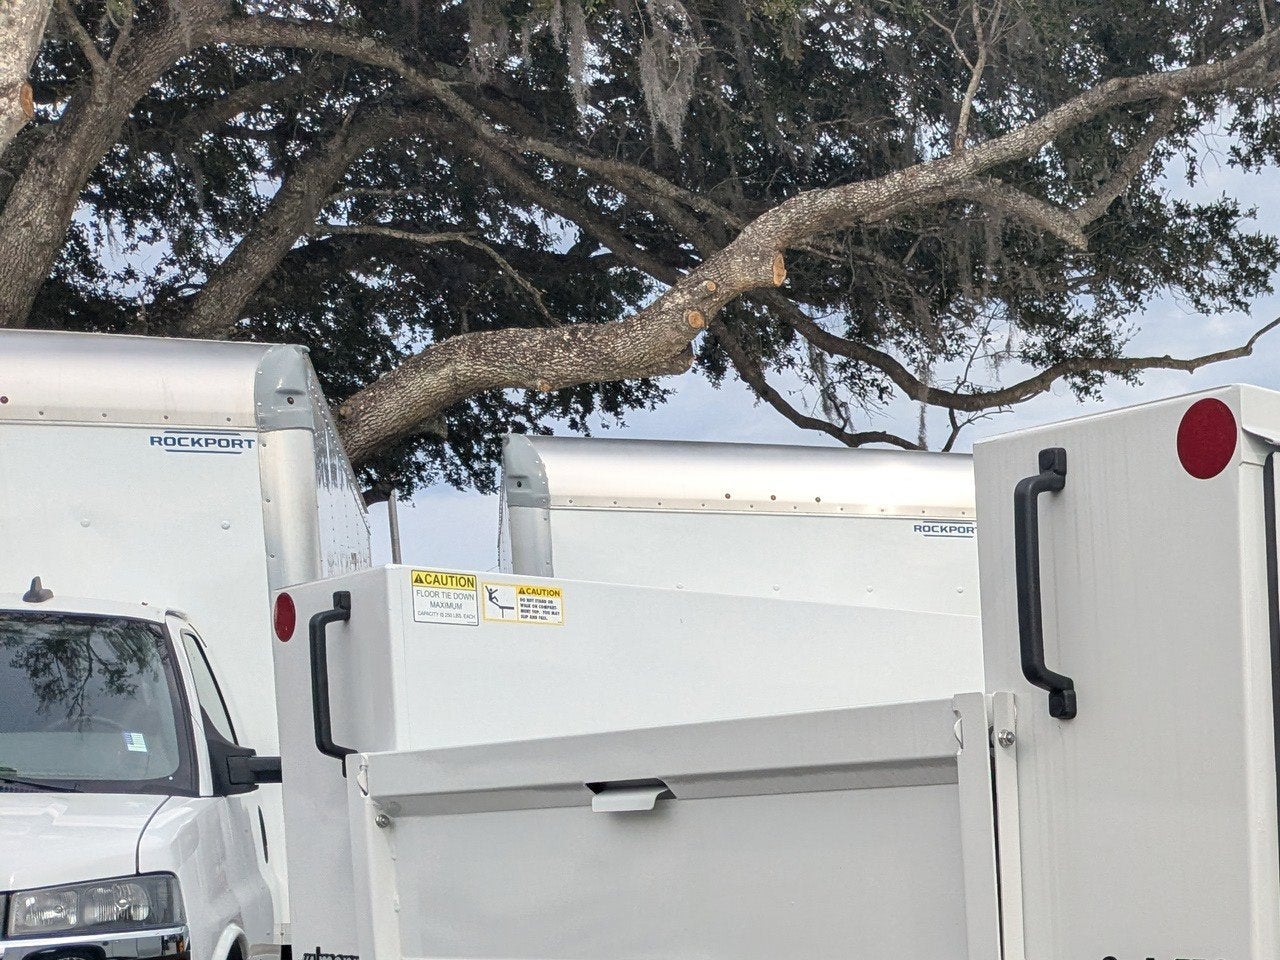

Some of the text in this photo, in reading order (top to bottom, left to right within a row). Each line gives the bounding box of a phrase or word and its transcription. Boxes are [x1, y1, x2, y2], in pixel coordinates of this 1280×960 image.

[150, 436, 255, 449] ROCKPORT
[913, 524, 977, 534] ROCKPOR
[424, 573, 475, 588] CAUTION
[416, 590, 440, 599] FLOOR
[453, 593, 475, 601] DOWN
[526, 588, 561, 597] CAUTION
